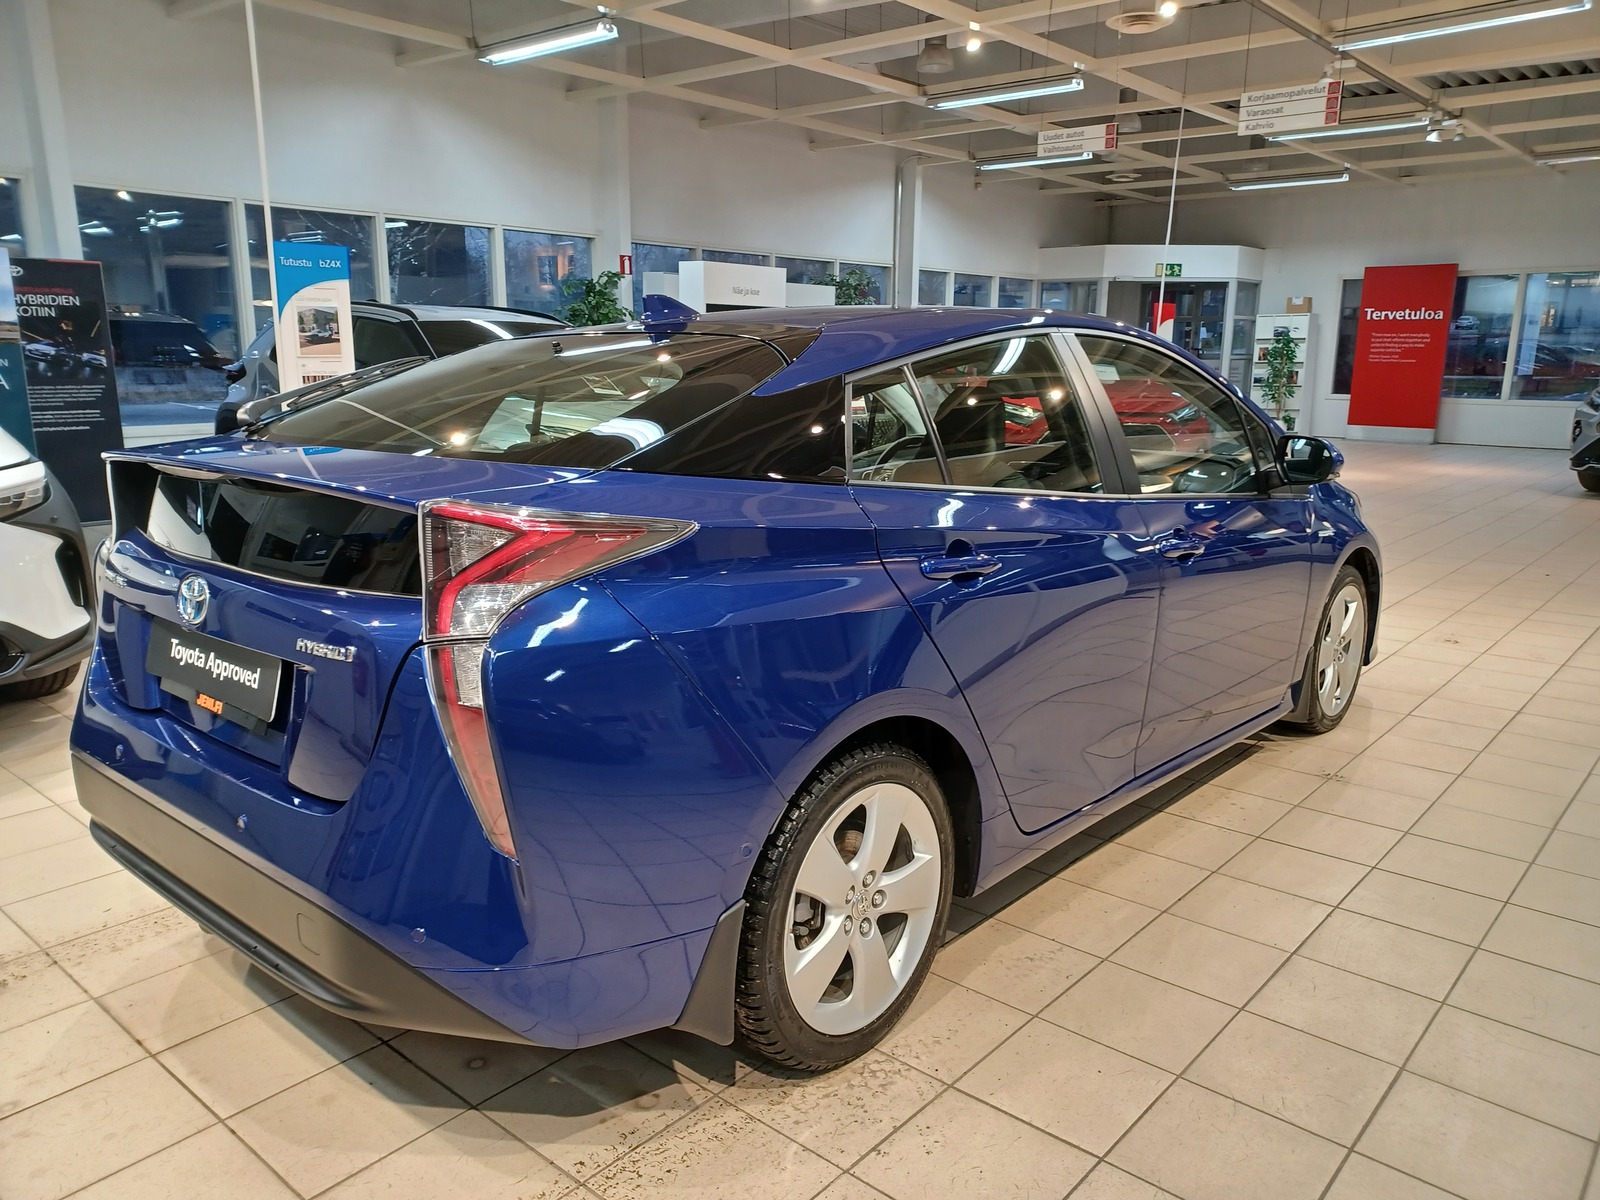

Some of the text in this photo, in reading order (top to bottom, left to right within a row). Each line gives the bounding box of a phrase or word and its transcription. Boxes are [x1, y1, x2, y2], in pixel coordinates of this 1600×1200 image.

[1247, 86, 1326, 103] Korjaamopalvelut
[1246, 106, 1284, 117] Varaosat
[1245, 121, 1274, 131] Kahvio
[1043, 130, 1085, 141] Uudet autot
[1042, 144, 1083, 153] Vaihtoautot
[279, 256, 341, 268] Tutustu bZ4X
[1364, 307, 1444, 320] Tervetuloa
[296, 637, 357, 662] HYBRID
[170, 638, 261, 689] Toyota Approved
